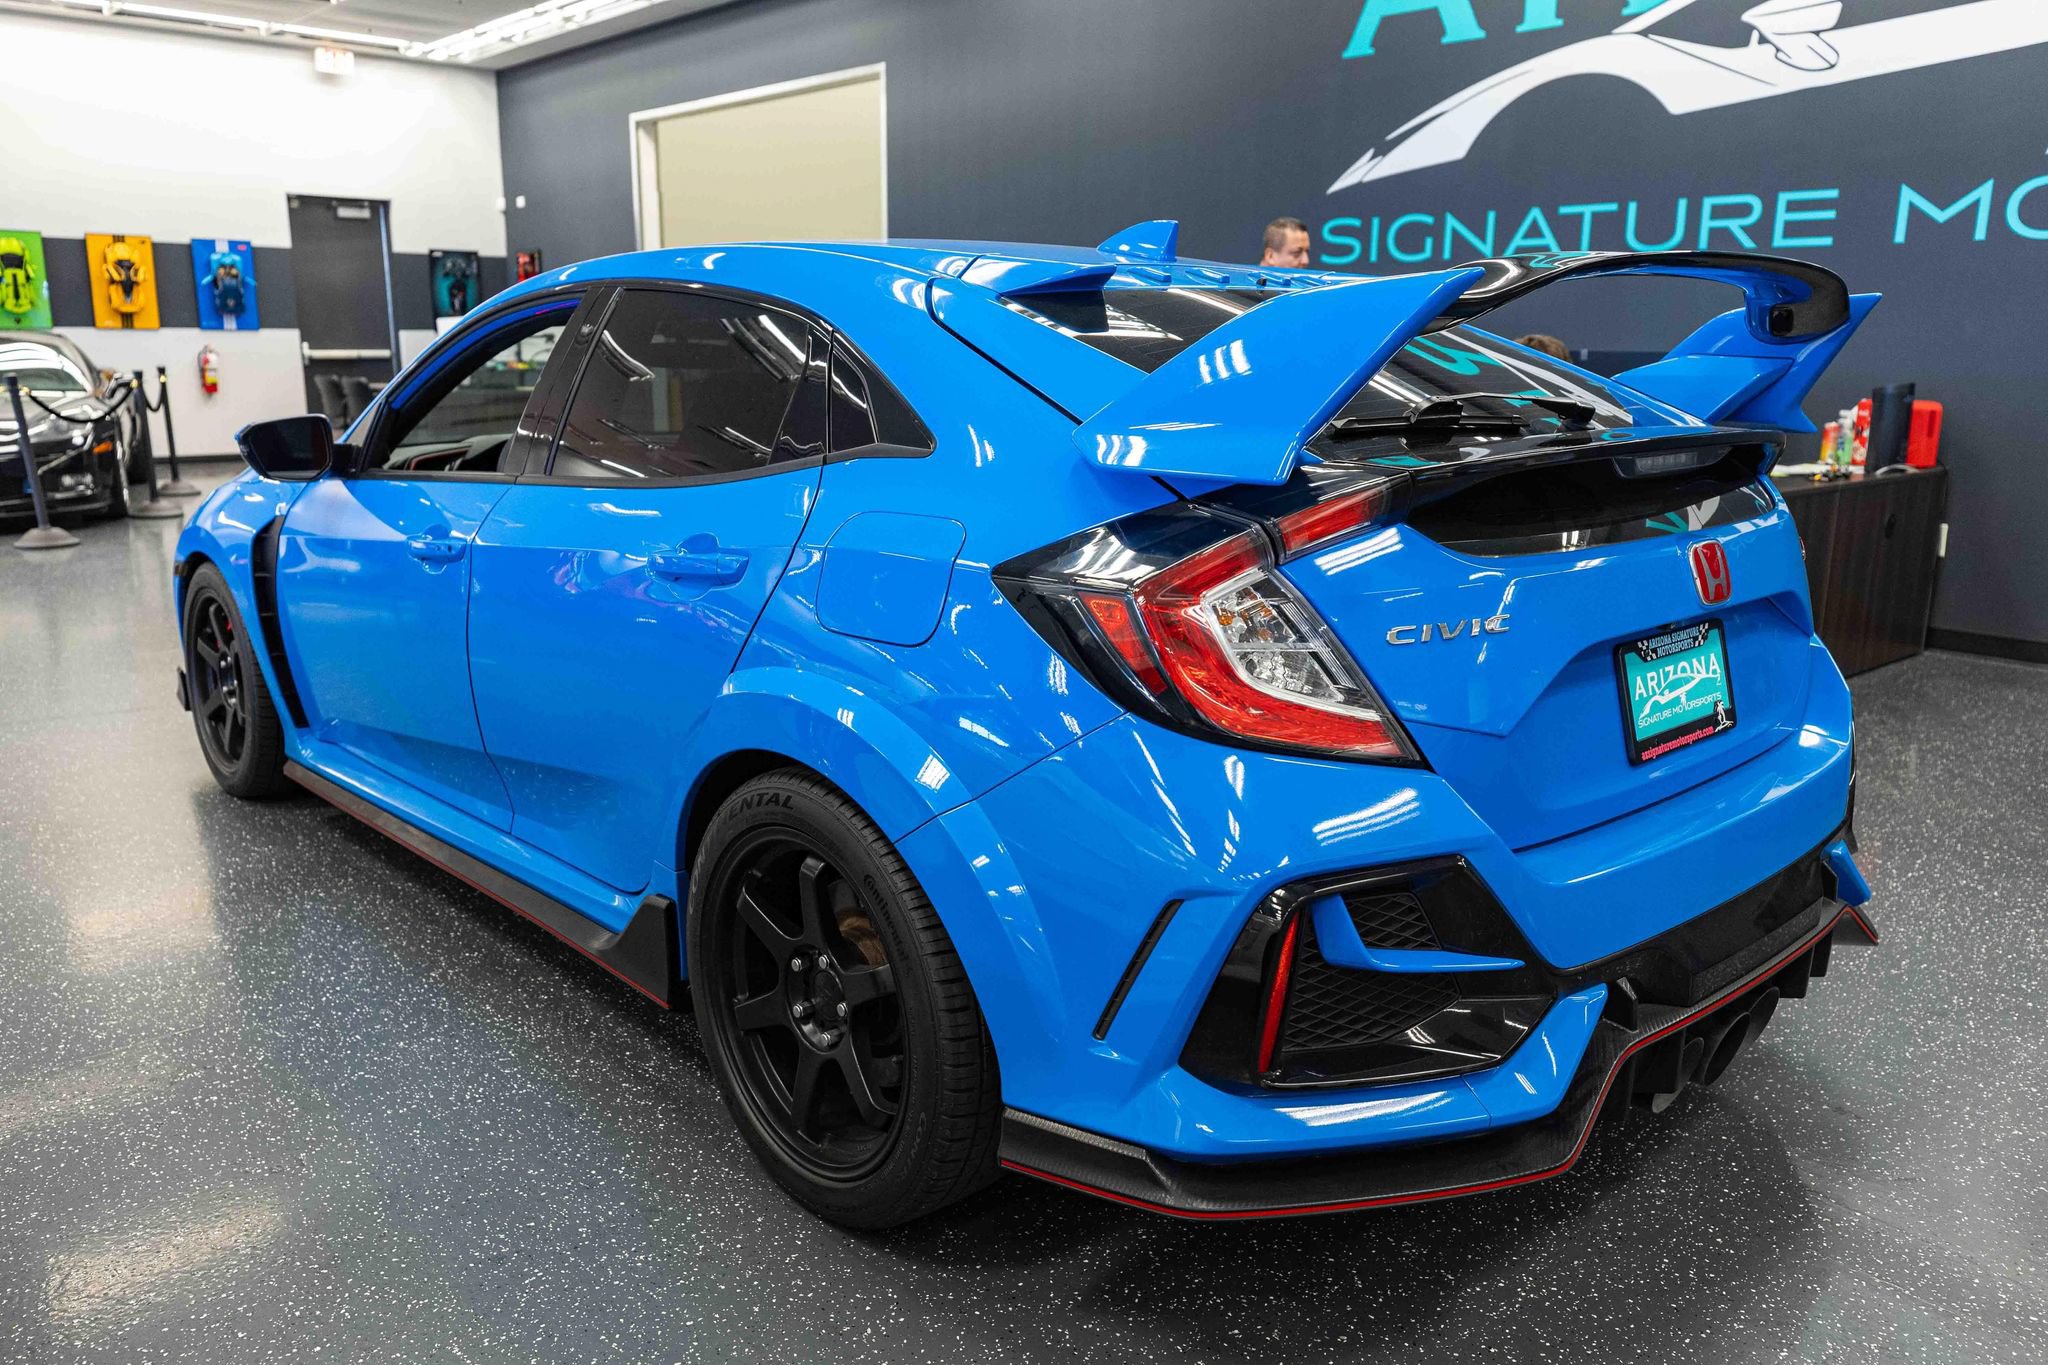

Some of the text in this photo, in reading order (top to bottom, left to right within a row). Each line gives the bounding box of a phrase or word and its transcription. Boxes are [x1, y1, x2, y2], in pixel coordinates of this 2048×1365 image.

[1320, 188, 1839, 265] SIGNATURE
[1386, 613, 1510, 645] CIVIC
[1648, 626, 1700, 649] ARIZONA SIGNATURE
[1657, 638, 1694, 658] MOTORSPORTS
[1635, 652, 1721, 701] ARIZONA
[1638, 709, 1672, 729] SIGNATURE
